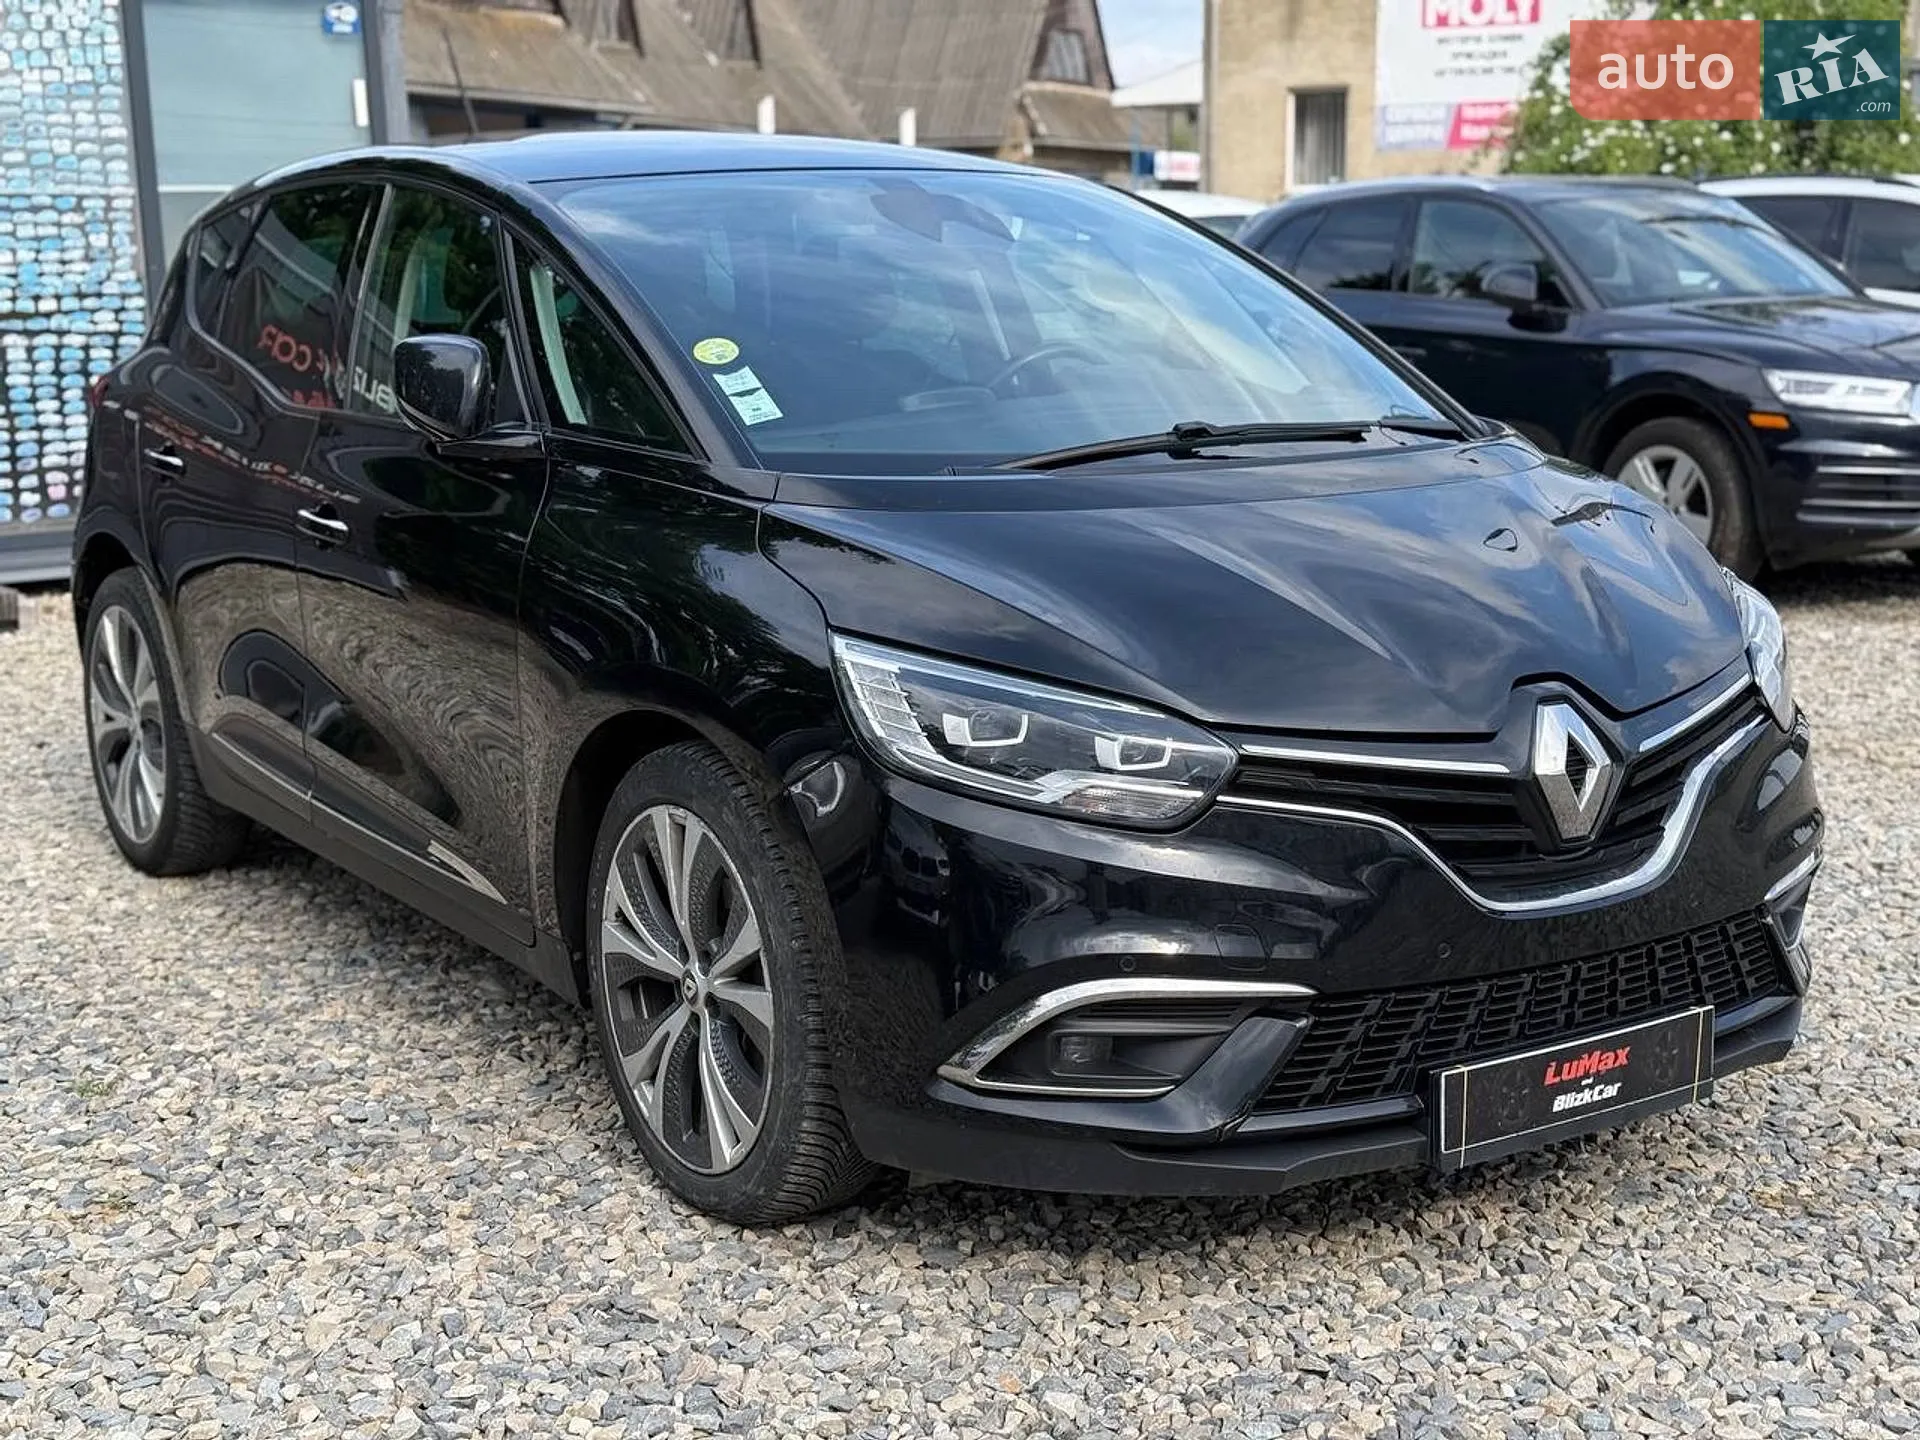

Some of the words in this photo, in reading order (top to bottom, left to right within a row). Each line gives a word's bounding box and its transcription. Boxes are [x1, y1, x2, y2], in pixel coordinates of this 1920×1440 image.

[1425, 0, 1534, 26] MOLY
[1544, 1046, 1631, 1087] LuMax
[1552, 1082, 1622, 1112] BlizkCar
